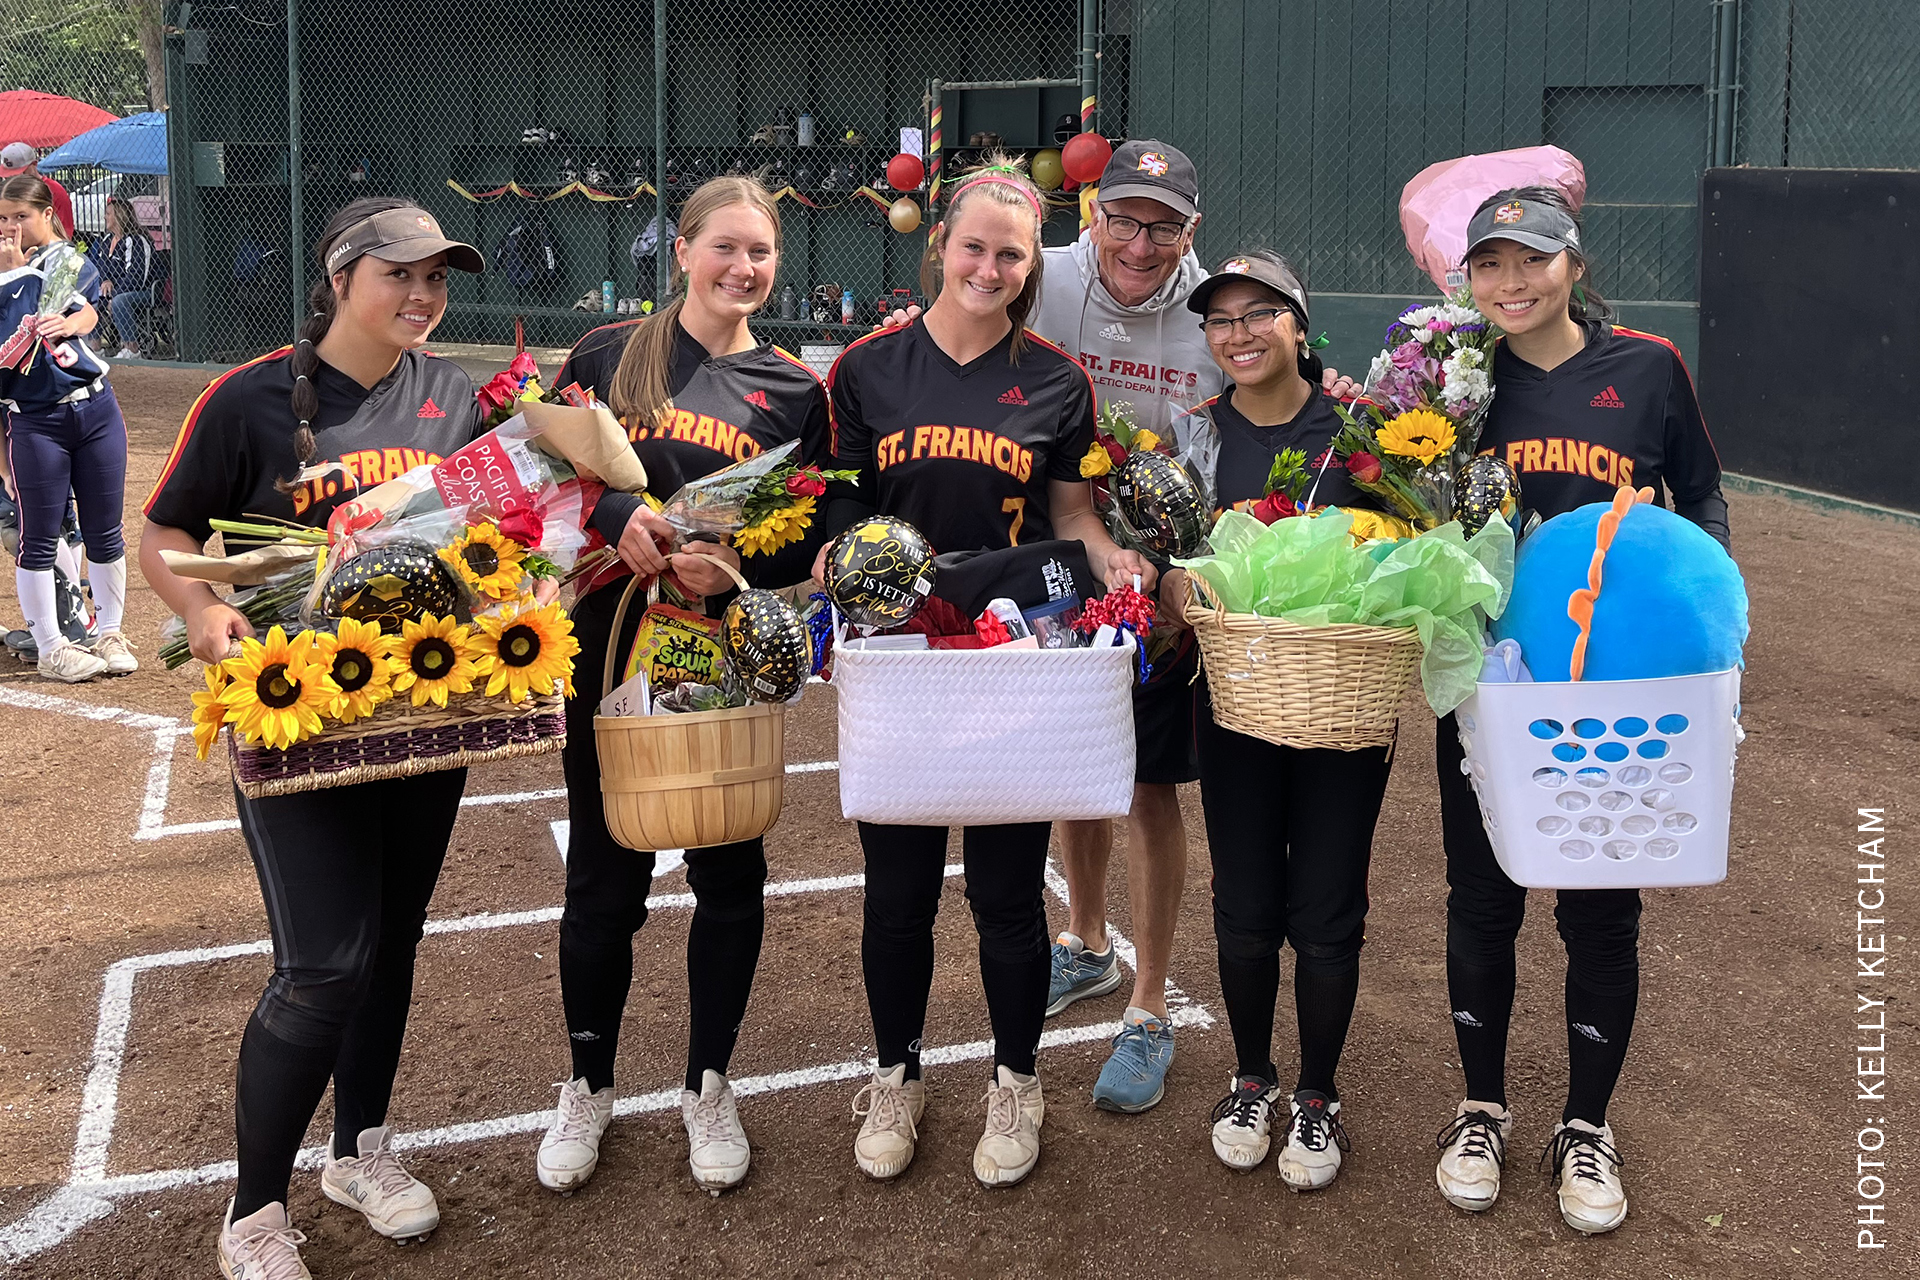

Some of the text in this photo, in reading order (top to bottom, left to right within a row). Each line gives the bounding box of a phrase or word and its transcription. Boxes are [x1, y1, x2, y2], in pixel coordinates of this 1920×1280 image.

[1137, 152, 1169, 177] SF
[1494, 203, 1524, 224] SF
[327, 242, 353, 271] OFTBALL
[1098, 330, 1132, 343] adidas
[1079, 351, 1104, 371] ST.
[997, 397, 1029, 406] adidas
[1590, 400, 1625, 409] adidas
[876, 424, 1034, 485] ST. FRANCIS
[1505, 436, 1635, 488] FRANCIS
[455, 455, 491, 512] COAST
[475, 444, 517, 512] PACIFIC
[1001, 496, 1026, 548] 7
[863, 539, 935, 593] Best
[903, 543, 925, 562] THE
[833, 569, 908, 619] Come
[862, 576, 916, 609] IS YET TO
[658, 645, 711, 675] SOUR
[744, 640, 766, 667] THE
